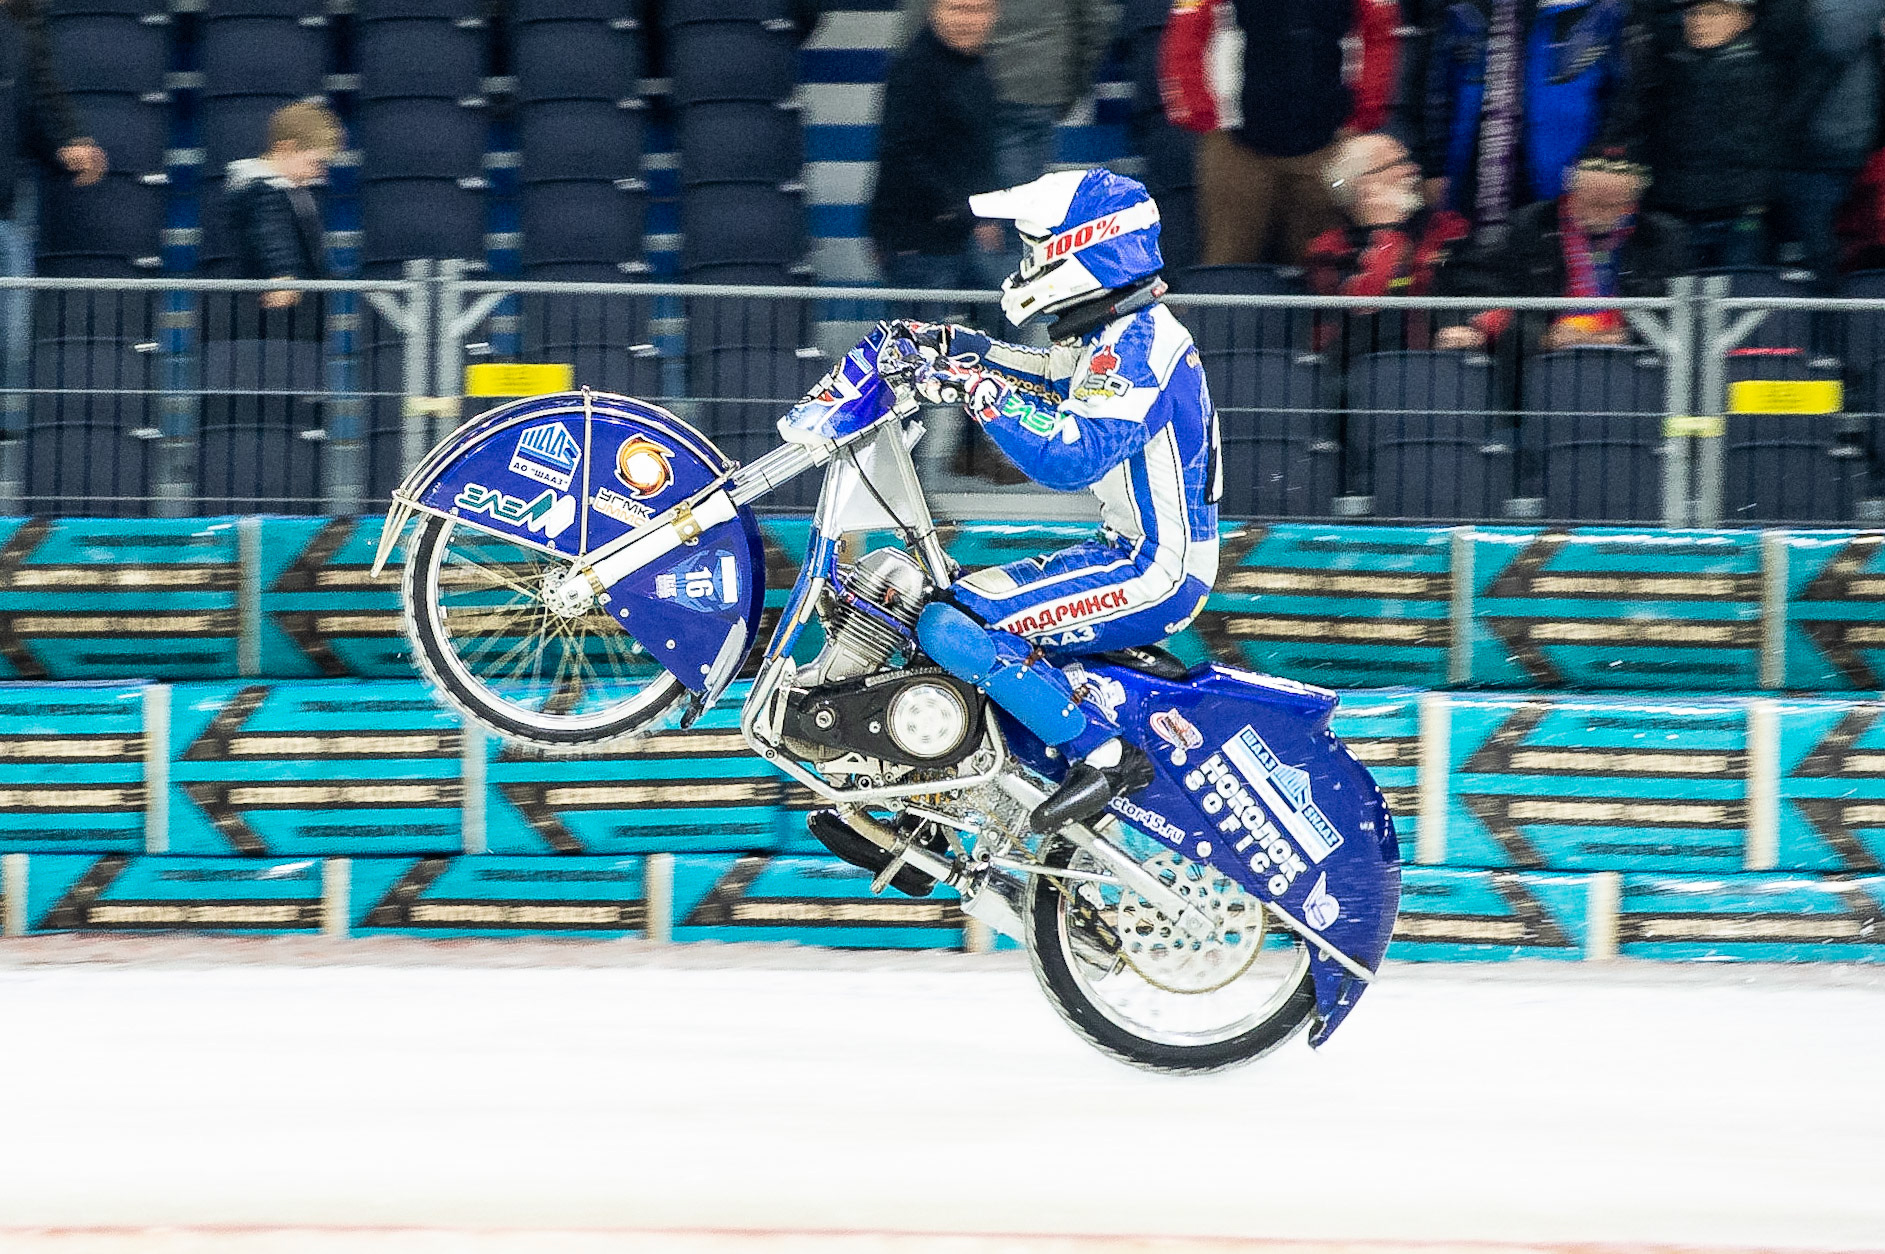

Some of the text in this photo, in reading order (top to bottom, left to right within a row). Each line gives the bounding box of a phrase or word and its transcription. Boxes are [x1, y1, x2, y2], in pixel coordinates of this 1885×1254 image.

[1043, 216, 1121, 262] 100%
[513, 462, 528, 473] АО
[599, 490, 651, 519] УГМК
[685, 566, 714, 598] 16
[1030, 625, 1096, 645] ААЗ
[1109, 796, 1186, 845] ctor45.ru
[1184, 769, 1290, 896] SOFICO
